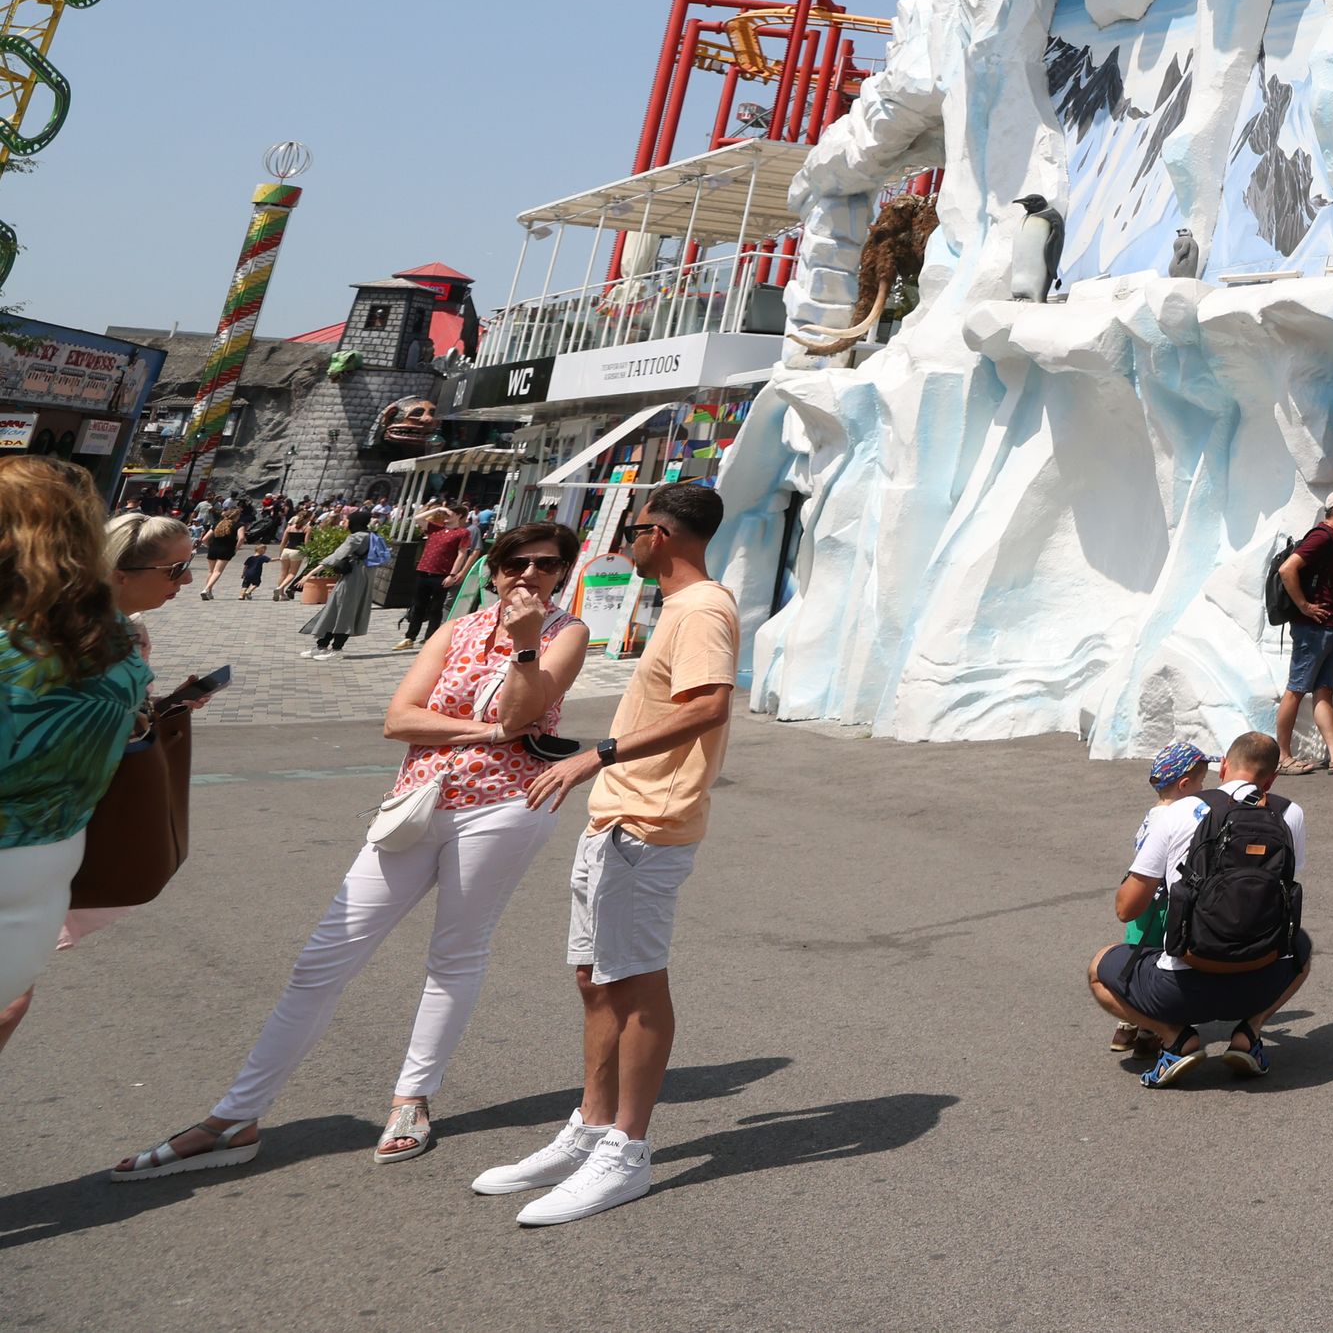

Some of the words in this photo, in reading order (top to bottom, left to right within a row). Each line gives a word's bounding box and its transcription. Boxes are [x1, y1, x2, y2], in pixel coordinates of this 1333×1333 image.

[65, 349, 118, 372] EXPRESS
[627, 354, 681, 377] TATTOOS
[507, 367, 534, 397] WC
